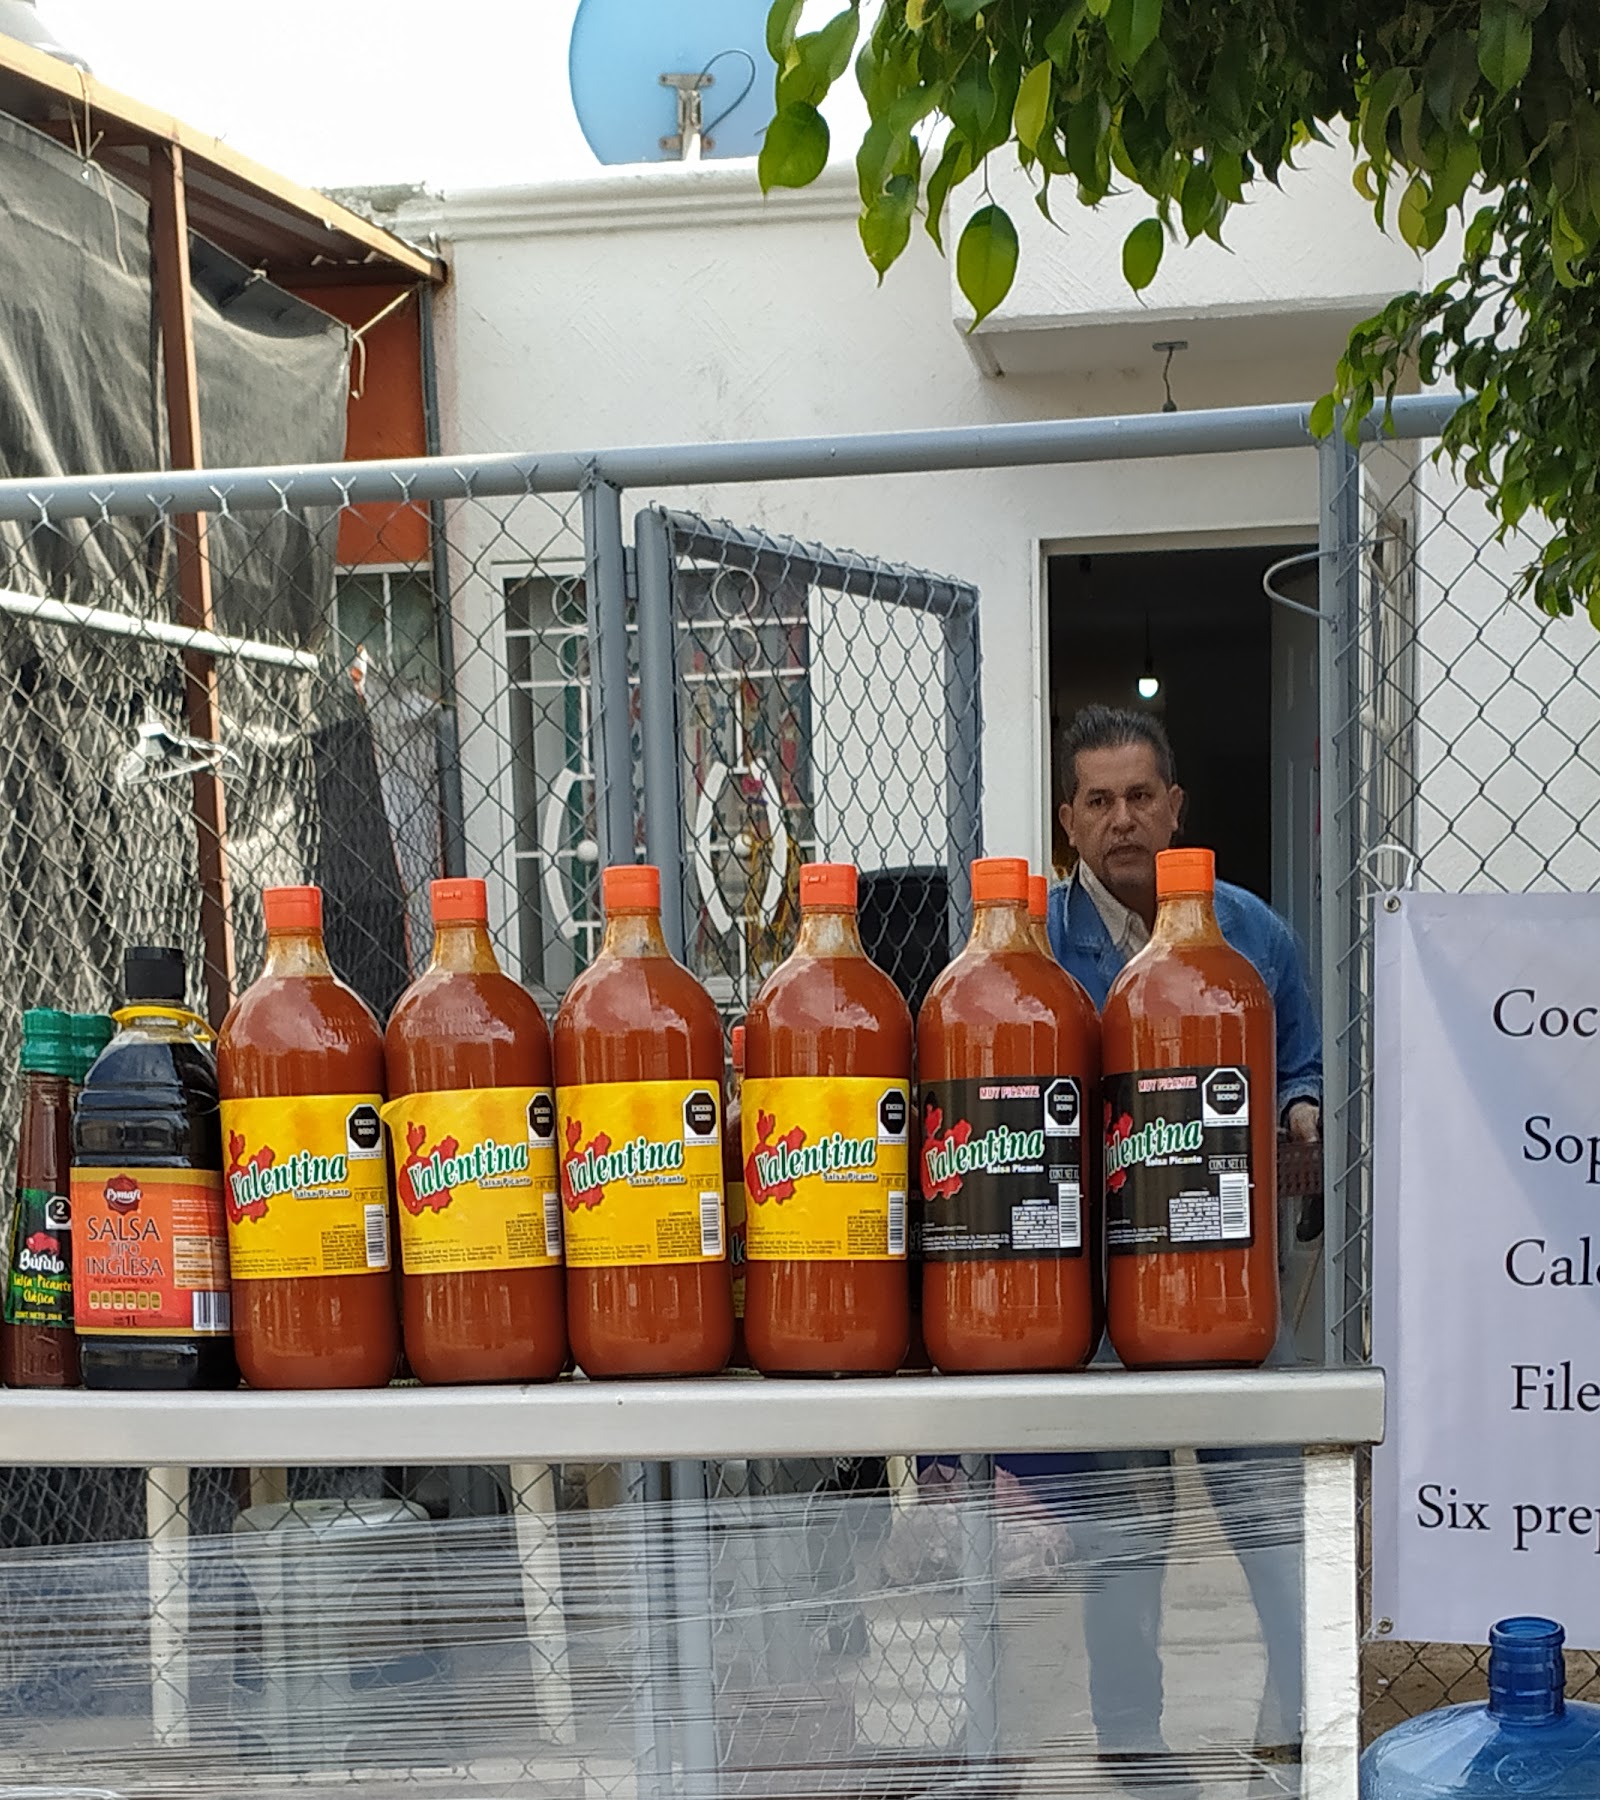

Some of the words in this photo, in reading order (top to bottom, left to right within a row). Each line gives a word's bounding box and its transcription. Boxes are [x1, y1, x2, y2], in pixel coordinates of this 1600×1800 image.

[756, 1132, 876, 1190] Valentina
[926, 1125, 1045, 1186] Valentina
[1145, 1157, 1167, 1167] Salsa
[1169, 1156, 1202, 1165] Picante
[407, 1138, 529, 1200] Valentina
[567, 1136, 683, 1197] Valentina
[986, 1165, 1010, 1174] Salsa
[1012, 1164, 1044, 1173] Picante
[230, 1149, 347, 1209] Valentina
[627, 1177, 653, 1187] Salsa
[655, 1176, 686, 1185] Picante
[822, 1172, 846, 1182] Salsa
[848, 1173, 878, 1182] Picante
[56, 1202, 65, 1215] 2
[87, 1216, 162, 1242] SALSA
[109, 1242, 140, 1257] TIPO
[19, 1248, 65, 1273] Búfalo
[85, 1257, 165, 1277] INGLESA
[13, 1273, 33, 1288] Salsa
[37, 1274, 72, 1292] Picante
[23, 1290, 55, 1305] Clásica
[1416, 1484, 1491, 1531] Six
